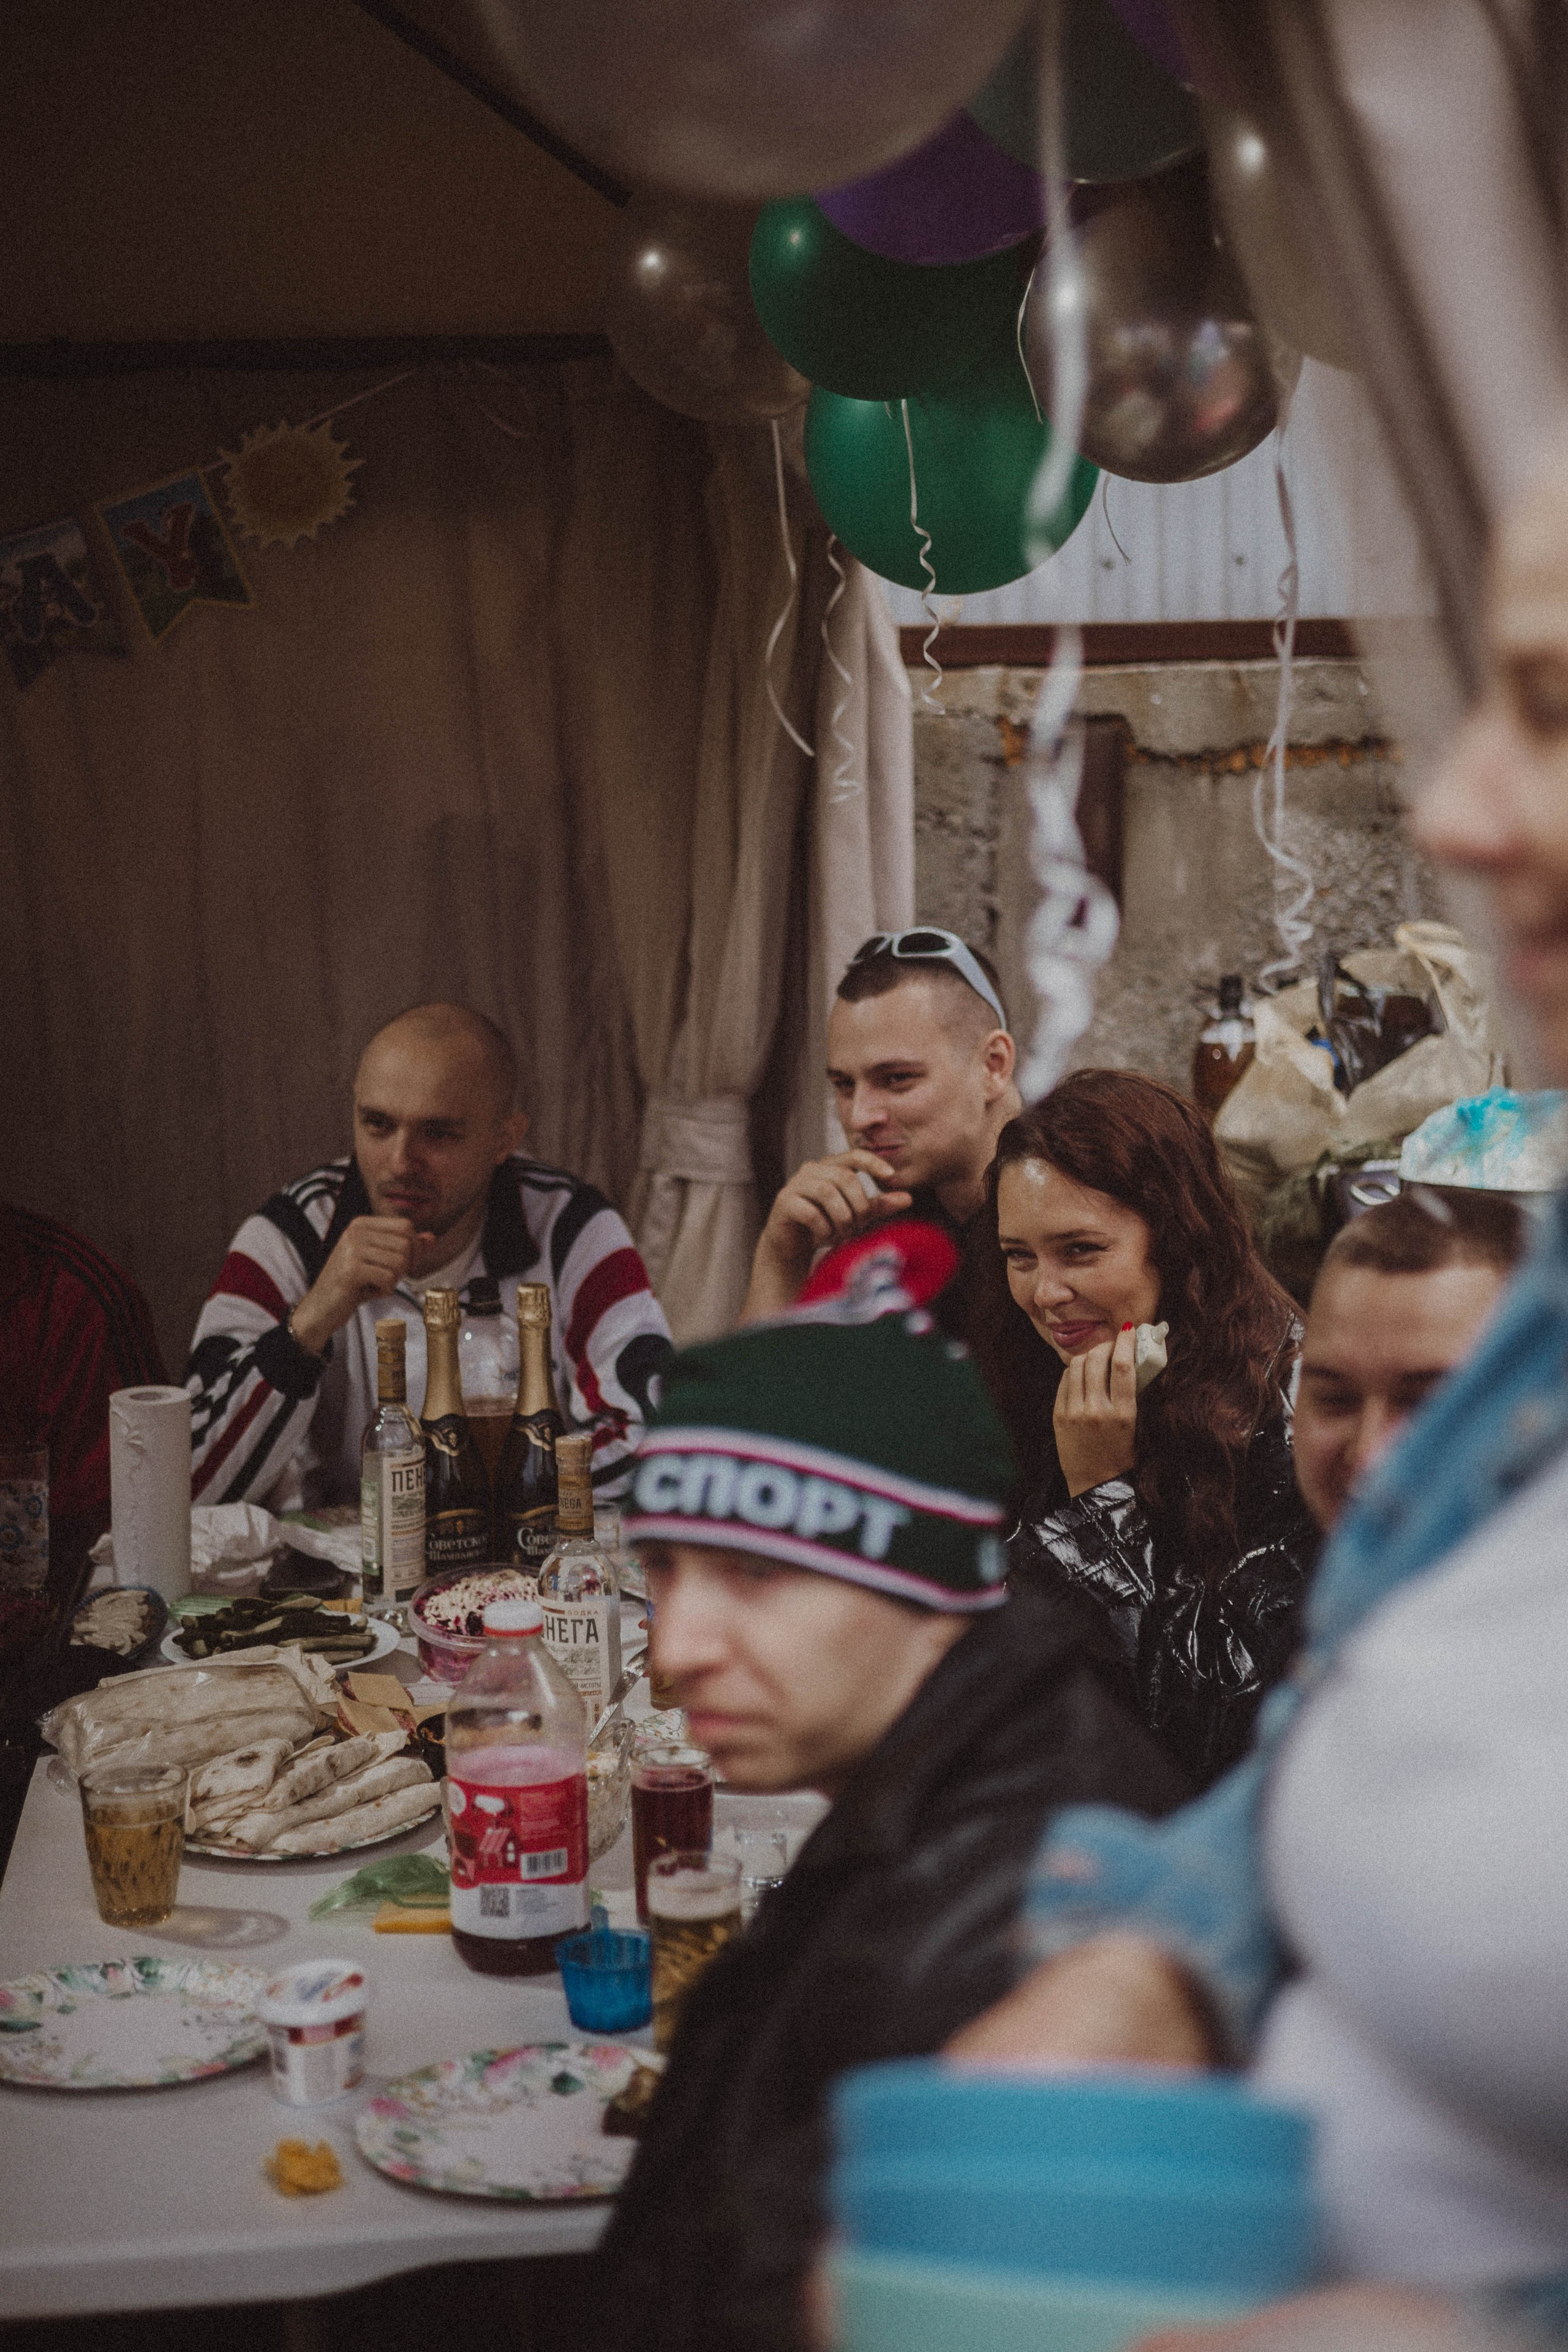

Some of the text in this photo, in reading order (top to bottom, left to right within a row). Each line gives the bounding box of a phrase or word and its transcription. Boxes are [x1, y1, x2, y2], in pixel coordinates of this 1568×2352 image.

[391, 1464, 425, 1491] ПЕН
[633, 1453, 913, 1559] СПОРТ
[541, 1615, 599, 1644] НЕГА
